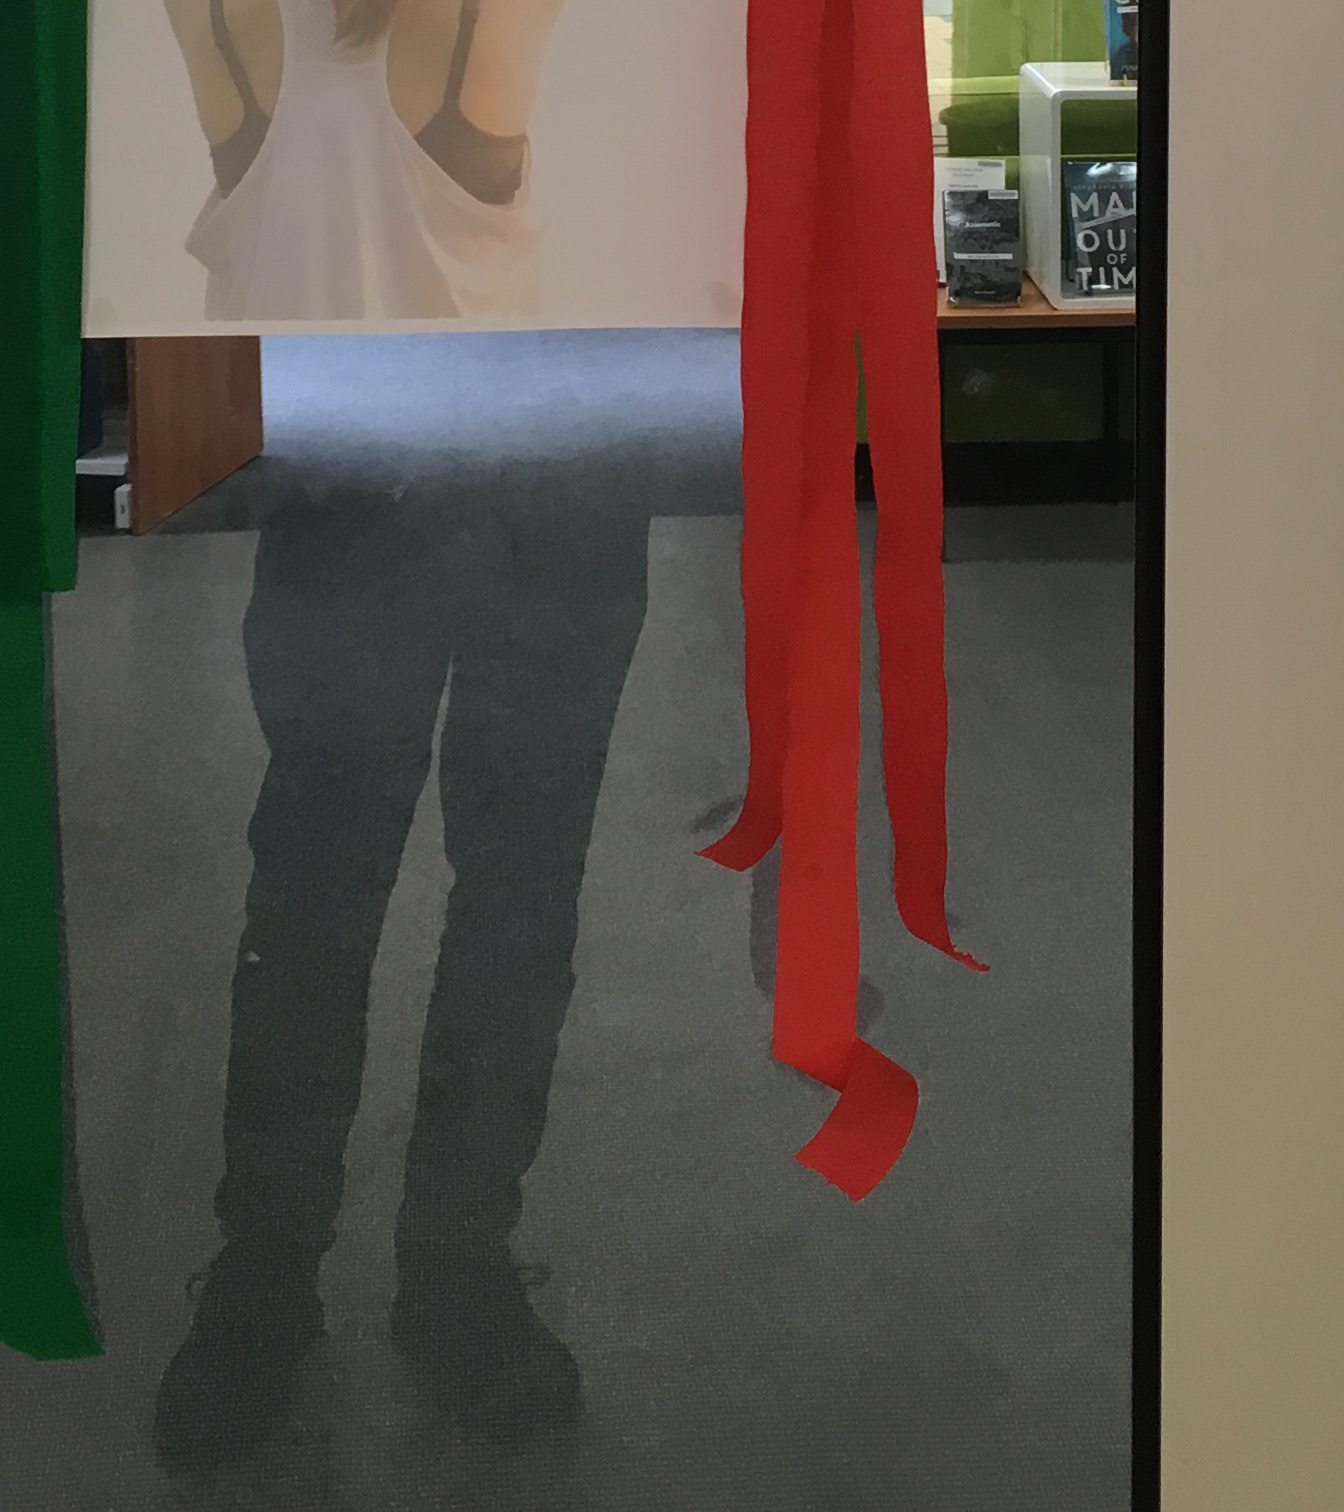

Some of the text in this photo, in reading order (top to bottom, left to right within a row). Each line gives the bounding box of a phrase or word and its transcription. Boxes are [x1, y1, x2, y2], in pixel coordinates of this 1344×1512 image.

[1070, 191, 1137, 217] MA
[1077, 229, 1137, 252] OU
[1106, 253, 1128, 265] OF
[1076, 266, 1137, 291] TIM
